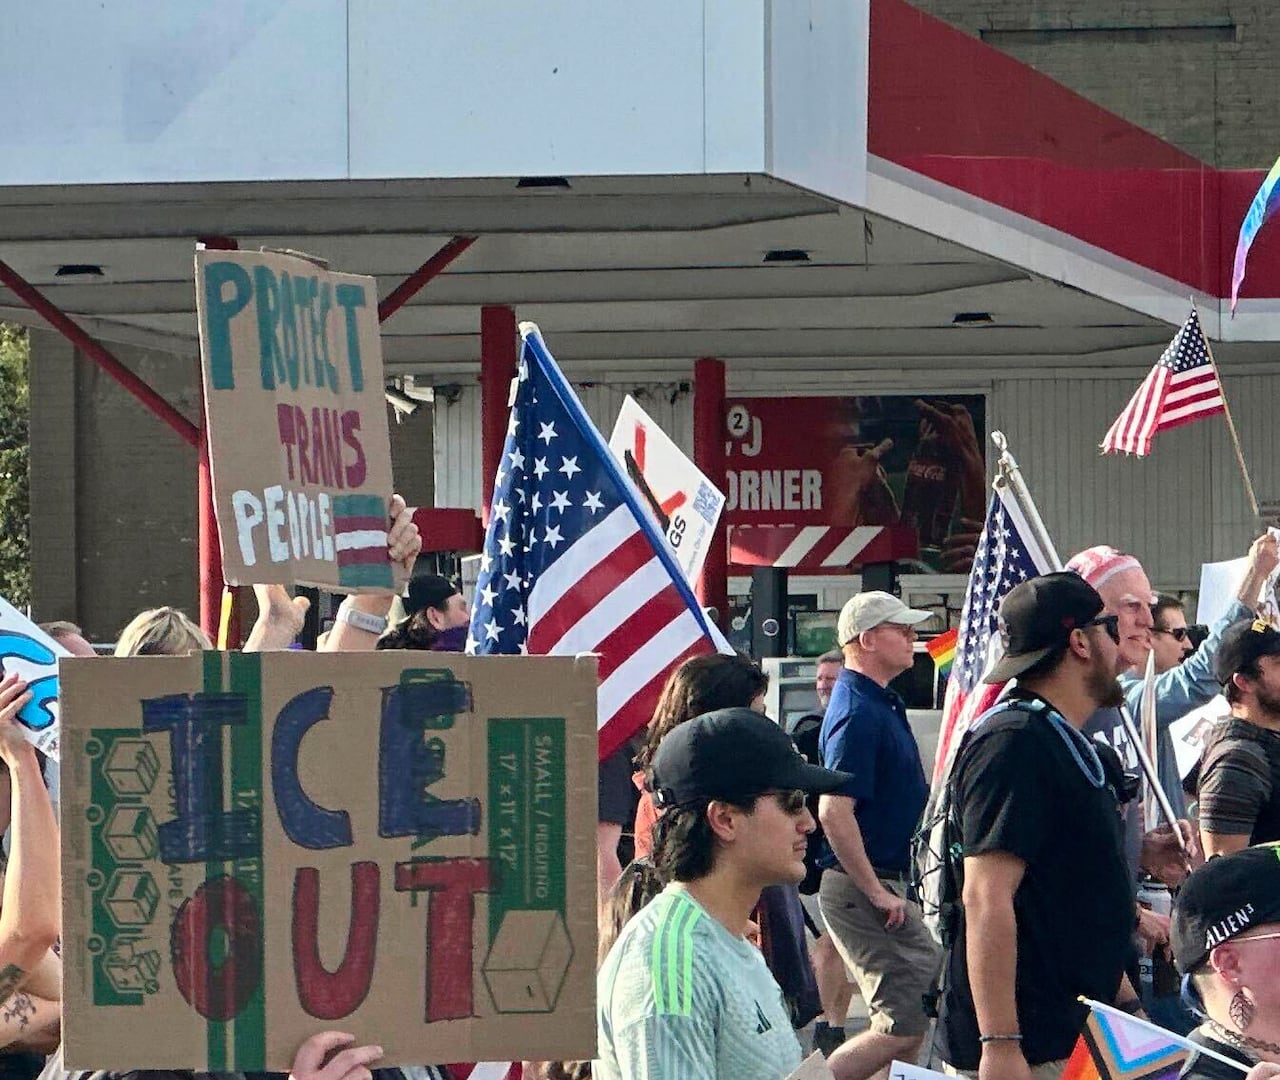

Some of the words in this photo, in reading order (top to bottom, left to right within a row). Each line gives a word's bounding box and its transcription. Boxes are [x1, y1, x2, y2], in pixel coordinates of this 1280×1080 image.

[205, 261, 366, 393] PROTECT
[277, 403, 367, 490] TRANS
[733, 413, 743, 429] 2
[231, 484, 335, 567] PEOPLE
[140, 681, 482, 865] ICE
[534, 735, 553, 801] SMALL
[171, 856, 502, 1024] OUT
